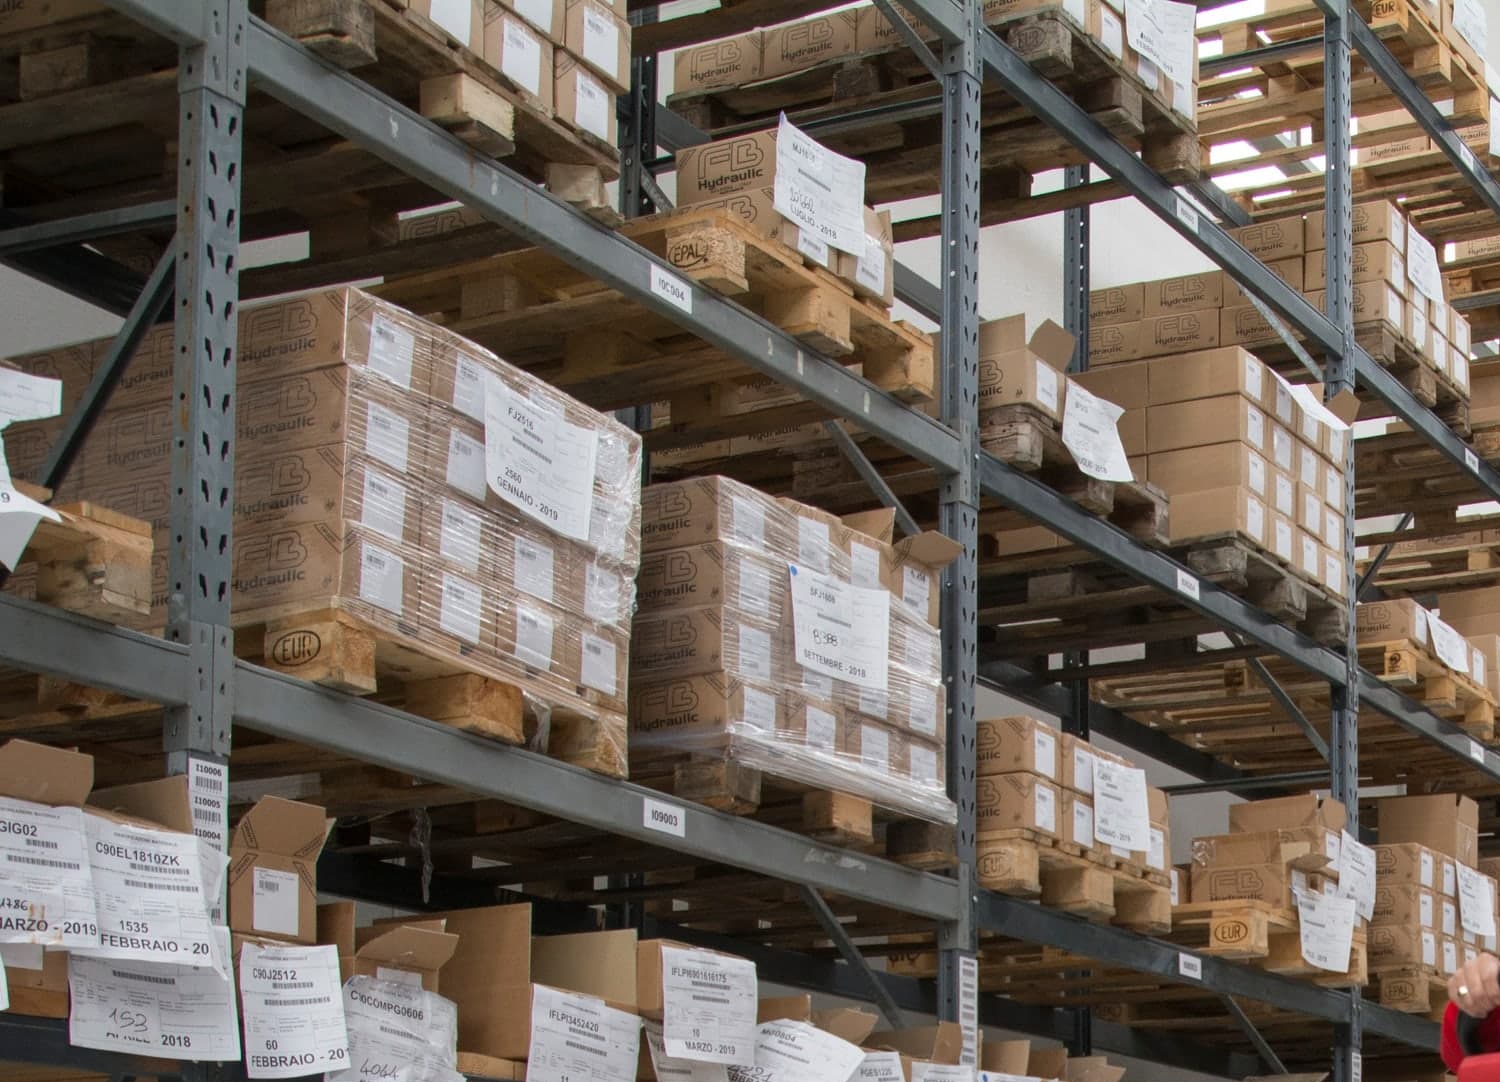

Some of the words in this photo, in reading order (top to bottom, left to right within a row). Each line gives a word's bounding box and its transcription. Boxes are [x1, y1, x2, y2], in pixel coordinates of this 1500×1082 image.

[1376, 1, 1395, 16] EUR
[782, 41, 833, 62] Hydraulic
[691, 63, 741, 81] Hydraulic
[698, 167, 763, 192] Hydraulic
[820, 225, 837, 239] 2018
[674, 241, 704, 262] EPAL
[1249, 242, 1283, 253] draulic
[1161, 294, 1204, 306] Hydraulic
[1090, 307, 1126, 318] ydraulic
[1155, 334, 1199, 344] Hydraulic
[240, 337, 316, 362] Hydraulic
[1090, 345, 1122, 355] draulic
[239, 414, 315, 439] Hydraulic
[497, 476, 533, 506] GENNAIO
[233, 492, 309, 516] Hydraulic
[641, 518, 690, 533] draulic
[231, 569, 305, 593] Hydraulic
[282, 635, 312, 662] EUR
[804, 649, 843, 671] SETTEMBRE
[635, 712, 698, 731] Hydraulic
[95, 841, 180, 866] C90EL1810ZK
[63, 922, 97, 936] 2019
[119, 920, 149, 934] 1535
[1222, 922, 1241, 939] EUR
[101, 934, 178, 953] FEBBRAIO
[253, 968, 297, 980] C90J2512
[161, 1034, 191, 1048] 2018
[266, 1040, 278, 1050] 60
[685, 1041, 713, 1053] MARZO
[720, 1044, 735, 1055] 2019
[251, 1053, 315, 1068] FEBBRAIO
